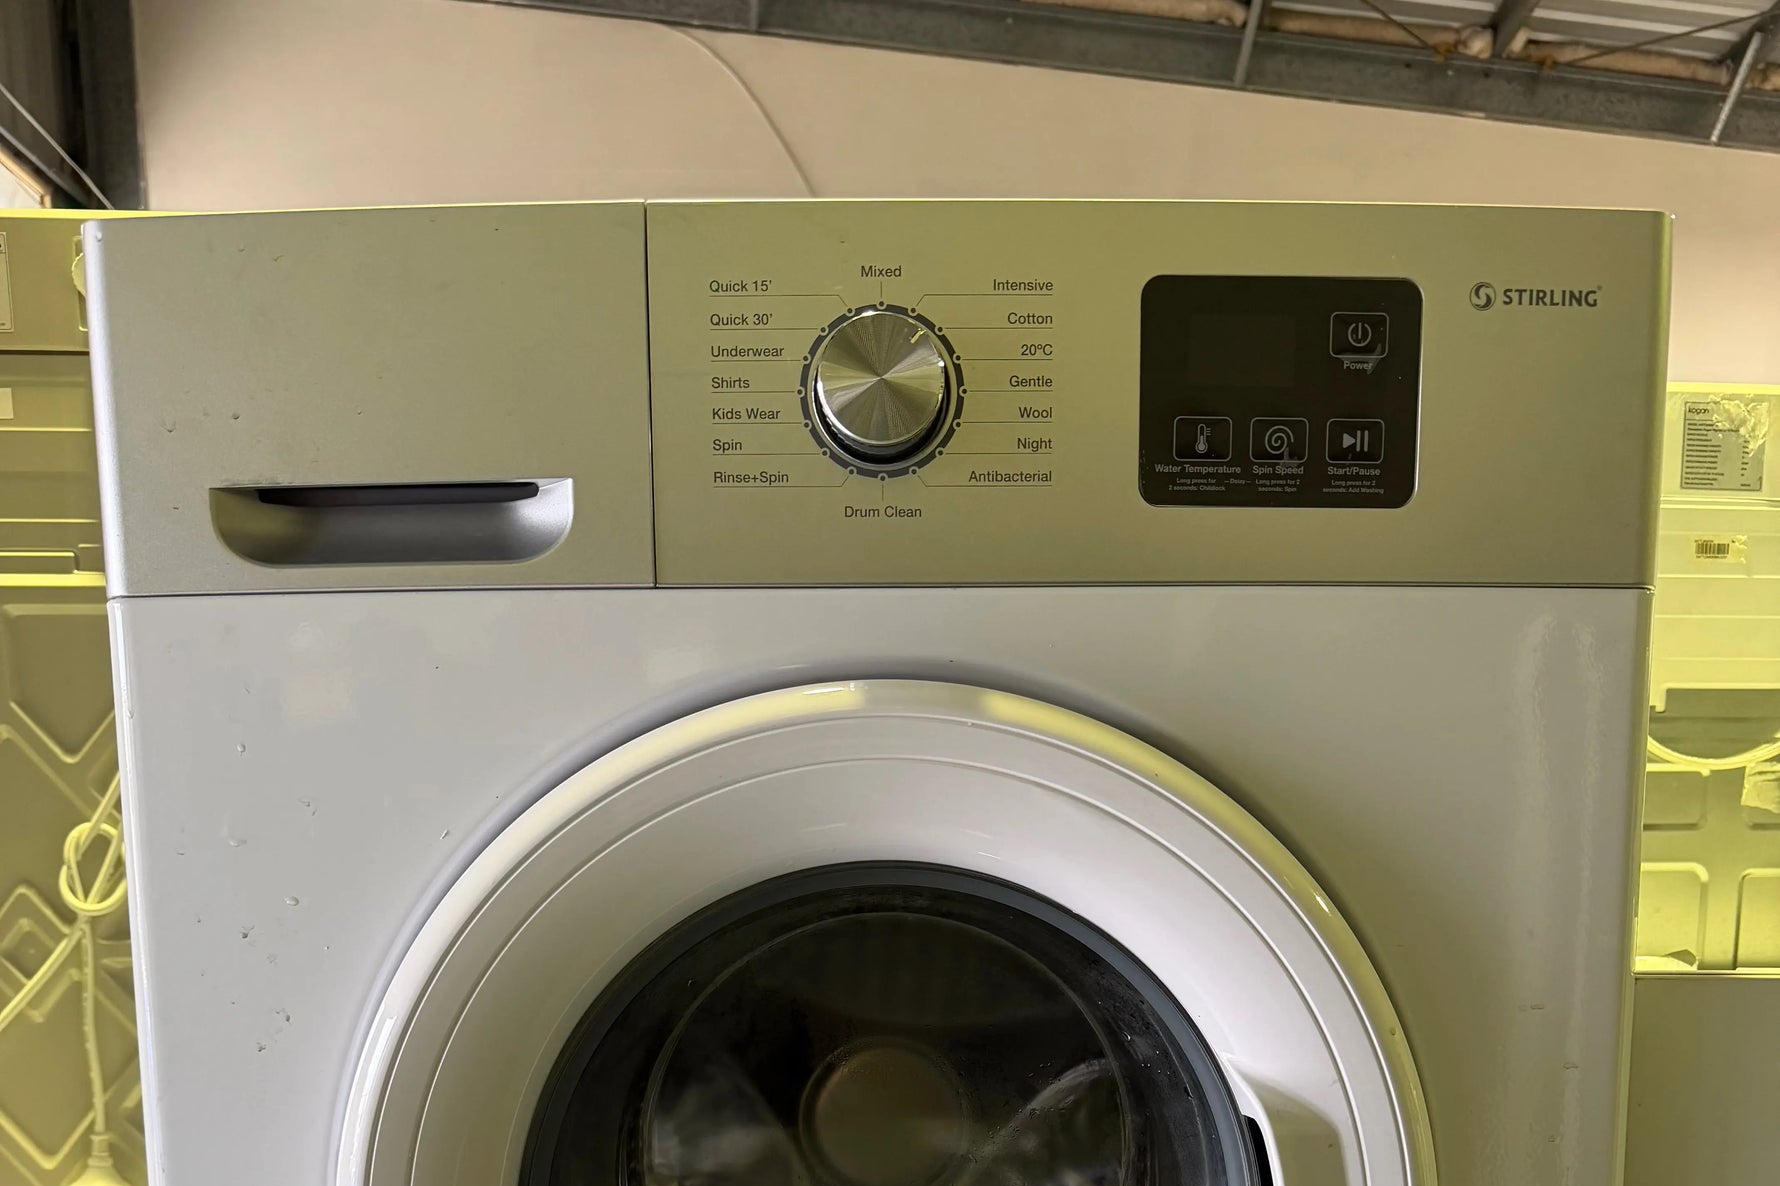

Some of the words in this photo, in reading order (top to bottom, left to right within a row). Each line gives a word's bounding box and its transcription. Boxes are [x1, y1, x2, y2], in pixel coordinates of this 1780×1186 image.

[861, 265, 902, 278] Mixed
[709, 280, 748, 293] Quick
[752, 280, 772, 292] 15'
[993, 279, 1053, 292] Intensive
[1502, 288, 1598, 307] STIRLING
[710, 313, 749, 326] Quick
[752, 313, 773, 326] 30'
[1007, 313, 1053, 325] Cotton
[711, 345, 784, 358] Underwear
[1343, 361, 1373, 370] Power
[711, 377, 750, 389] Shirts
[1009, 376, 1053, 388] Gentle
[712, 408, 742, 420] Kids
[745, 408, 780, 420] Wear
[1018, 407, 1053, 419] Wool
[712, 439, 742, 454] Spin
[1016, 438, 1053, 452] Night
[1155, 464, 1182, 473] Water
[1184, 465, 1242, 475] Temperature
[1252, 466, 1273, 476] Spin
[1274, 466, 1304, 476] Speed
[1327, 466, 1381, 476] Start/Pause
[713, 471, 789, 486] Rinse+Spin
[968, 471, 1052, 483] Antibacterial
[844, 506, 880, 518] Drum
[884, 506, 922, 518] Clean
